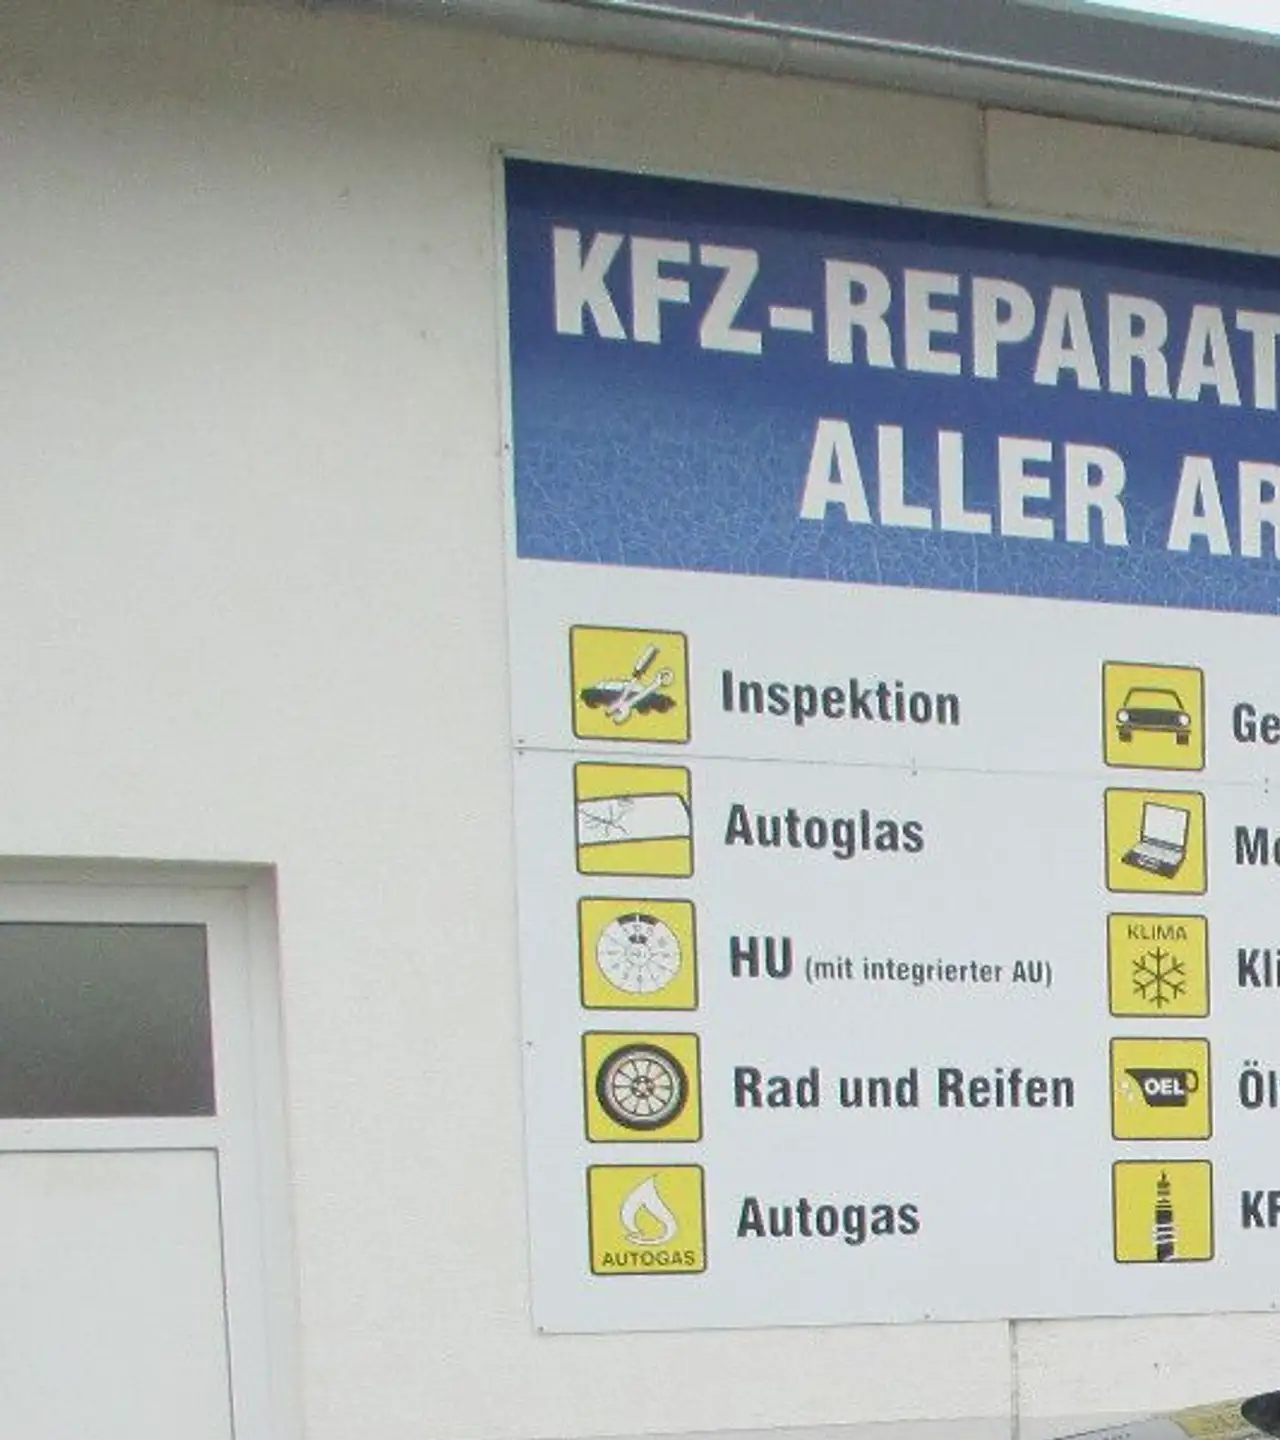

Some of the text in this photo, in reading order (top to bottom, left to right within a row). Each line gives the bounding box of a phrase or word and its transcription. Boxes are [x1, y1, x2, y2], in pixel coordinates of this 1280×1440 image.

[800, 419, 1130, 547] ALLER
[720, 669, 961, 727] Inspektion
[724, 804, 925, 860] Autoglas
[1127, 923, 1188, 942] KLIMA
[730, 935, 1053, 988] HU (mit integrierter AU)
[733, 1066, 1076, 1109] Rad und Reifen
[1143, 1077, 1186, 1097] OEL
[736, 1196, 921, 1246] Autogas
[602, 1248, 697, 1269] AUTOGAS
